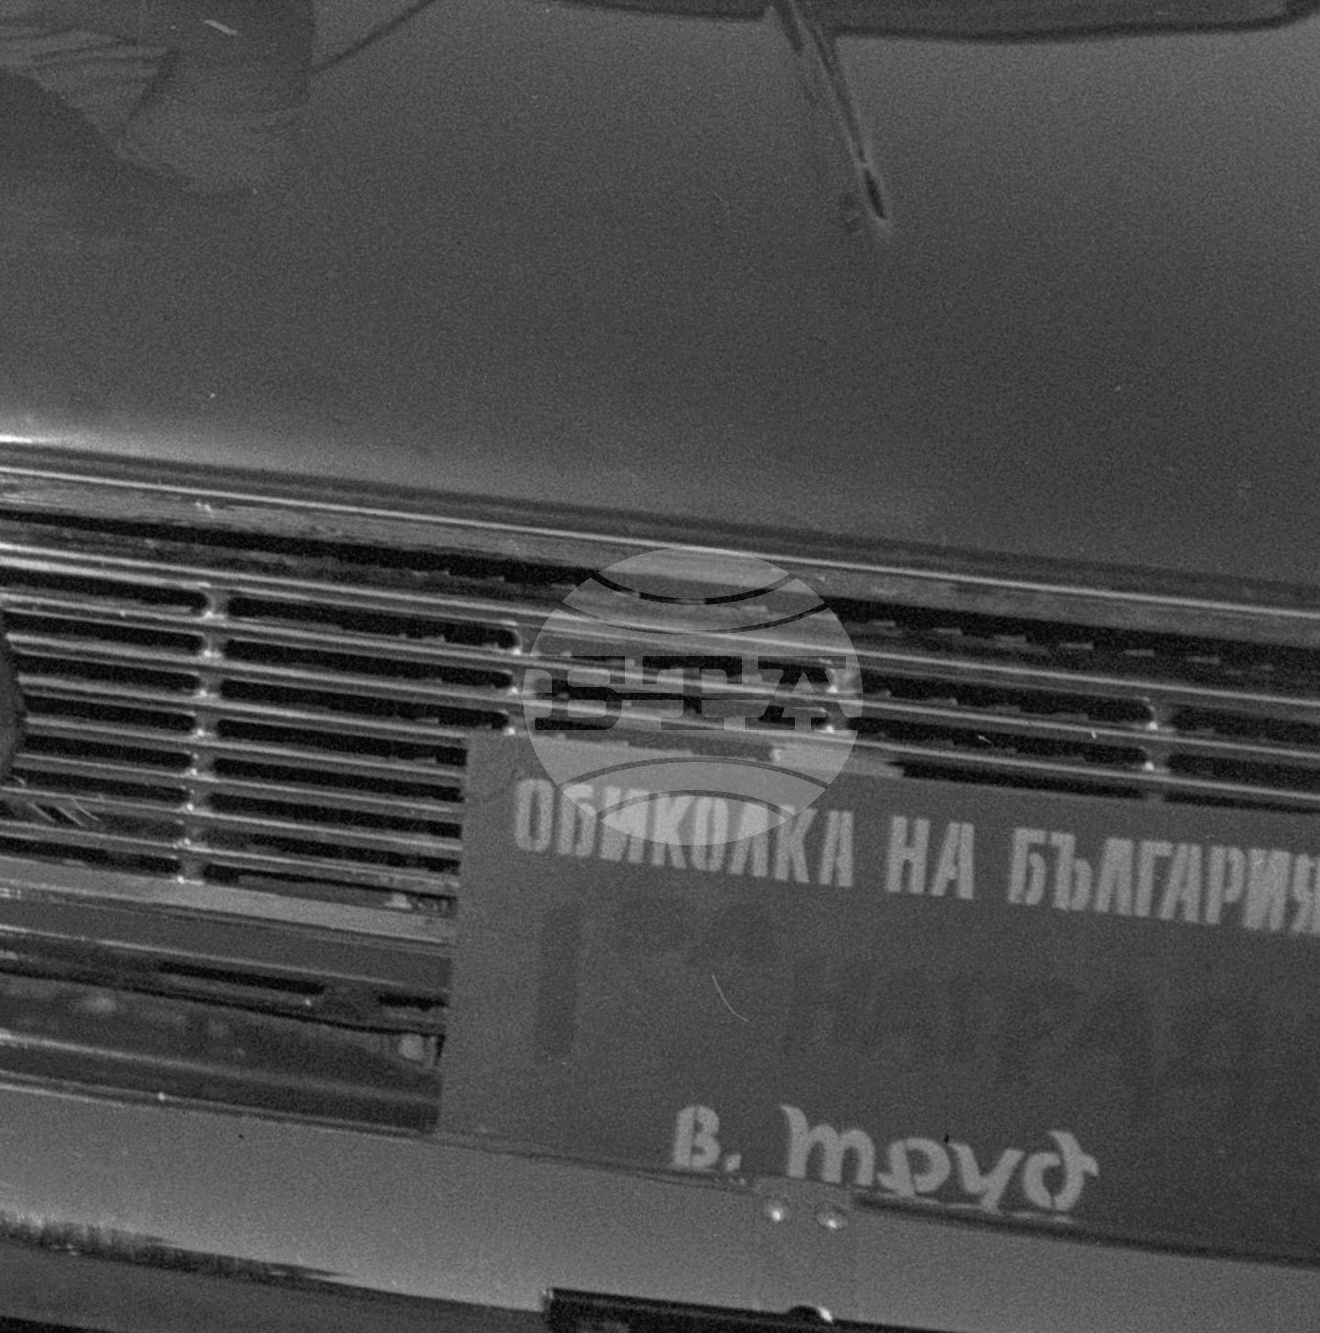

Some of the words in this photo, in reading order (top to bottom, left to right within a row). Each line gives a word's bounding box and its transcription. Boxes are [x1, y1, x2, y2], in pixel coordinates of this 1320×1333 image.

[513, 778, 854, 887] ОБИКОЛКА
[884, 814, 977, 901] НА
[1007, 826, 1320, 936] БЪЛГАРИЯ
